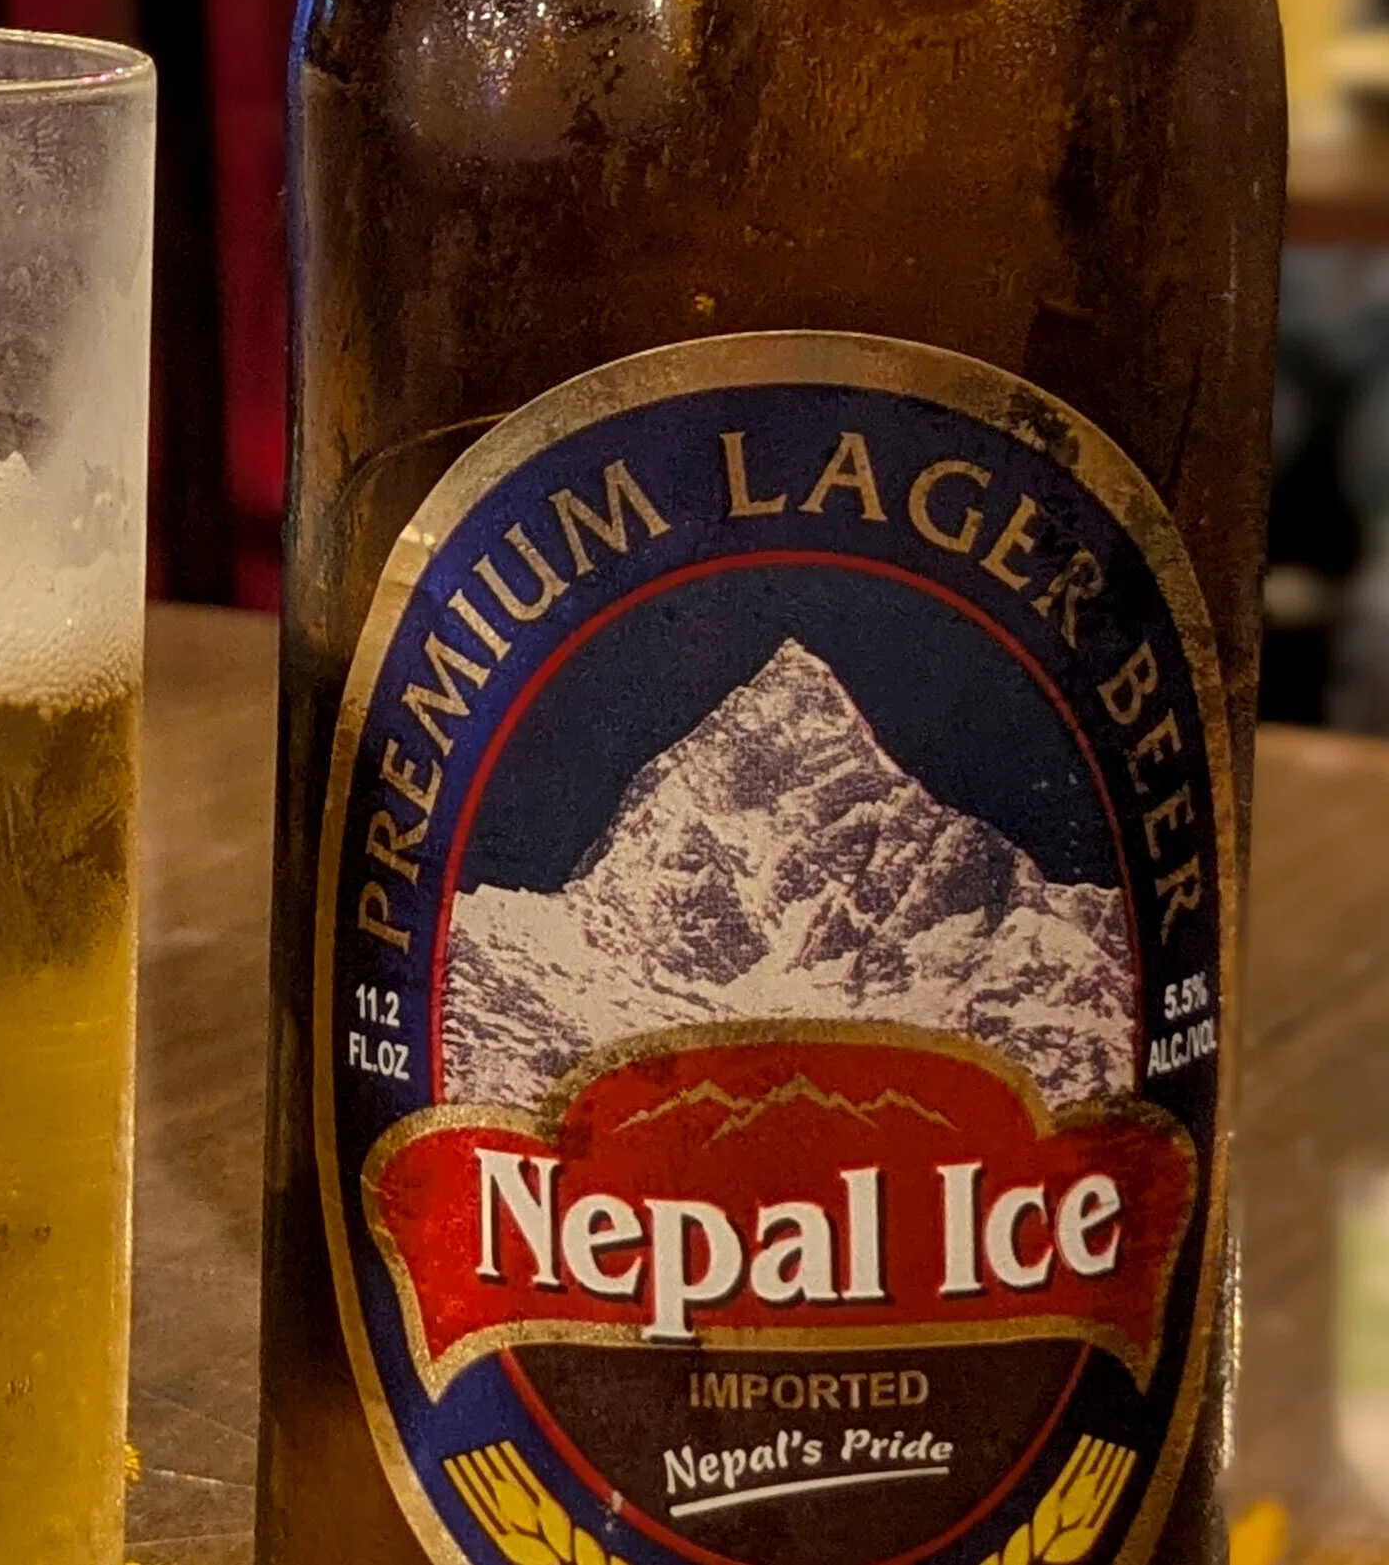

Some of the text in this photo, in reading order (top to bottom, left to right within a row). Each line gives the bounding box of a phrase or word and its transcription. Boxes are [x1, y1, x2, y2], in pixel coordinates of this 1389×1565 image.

[357, 430, 1203, 955] PREMIUM LAGER BEER
[354, 982, 401, 1028] 11.2
[1163, 970, 1209, 1021] 5.5%
[348, 1030, 411, 1081] FL.OZ
[473, 1147, 1124, 1341] Nepal Ice
[688, 1369, 930, 1410] IMPORTED
[662, 1427, 954, 1495] Nepal's Pride
